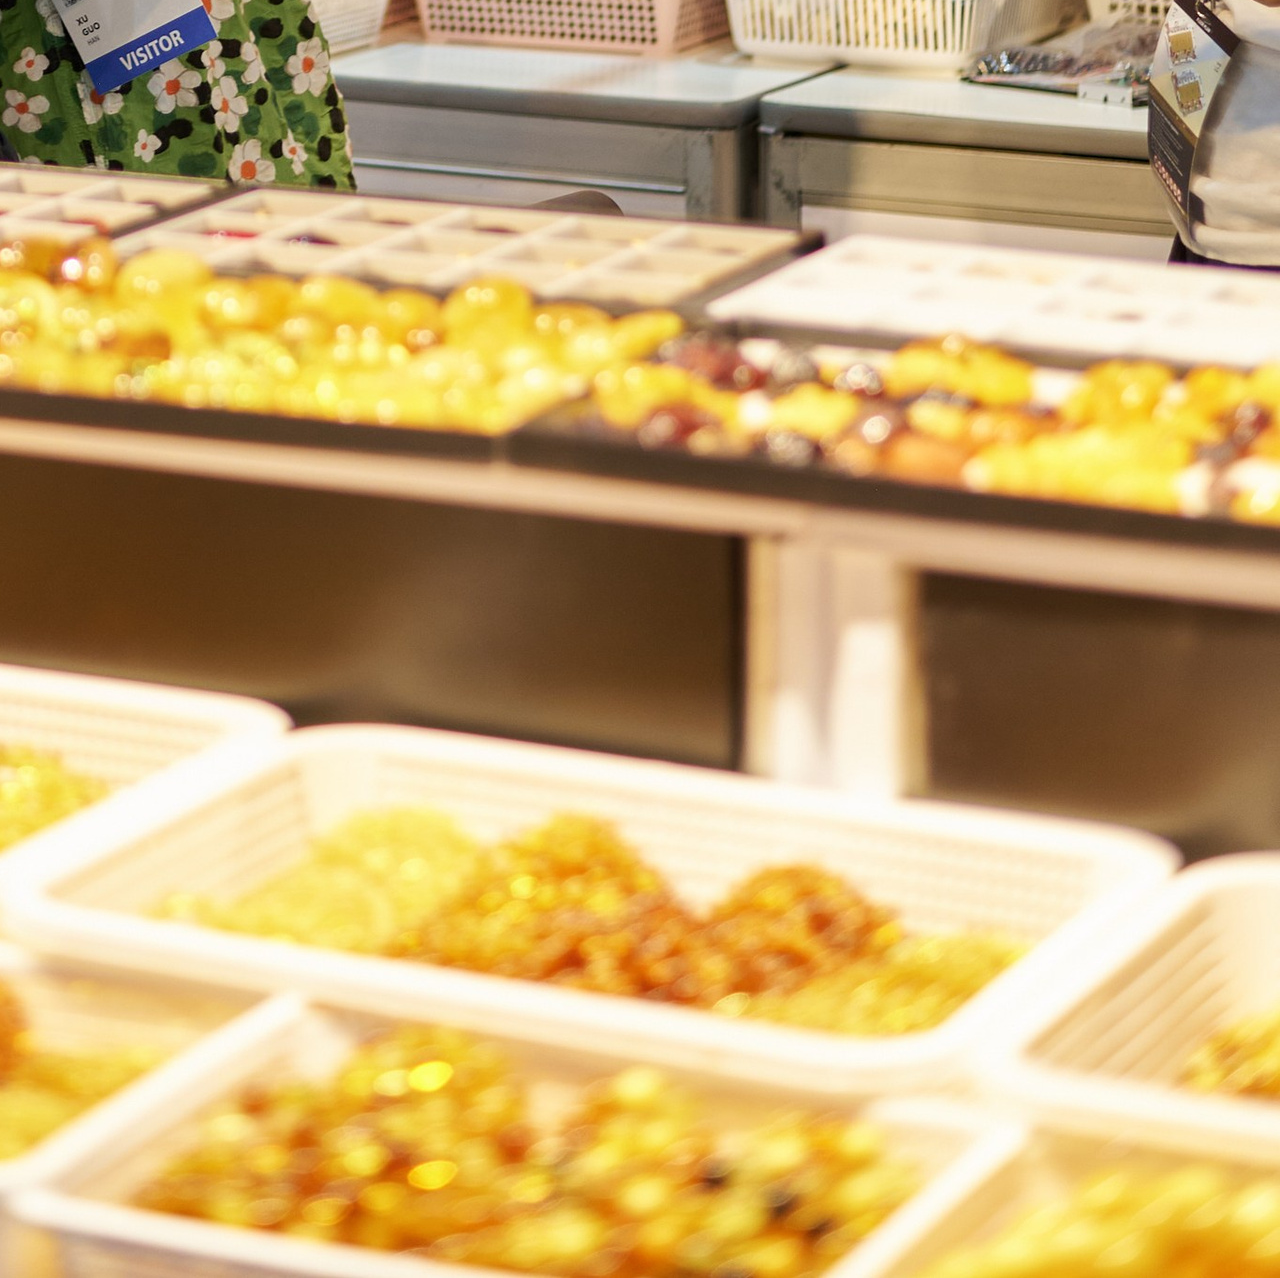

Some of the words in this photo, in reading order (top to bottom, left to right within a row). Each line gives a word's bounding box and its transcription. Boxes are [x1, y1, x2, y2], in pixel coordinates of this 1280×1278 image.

[75, 14, 89, 27] XU
[82, 22, 101, 37] GUO
[119, 29, 185, 71] VISITOR
